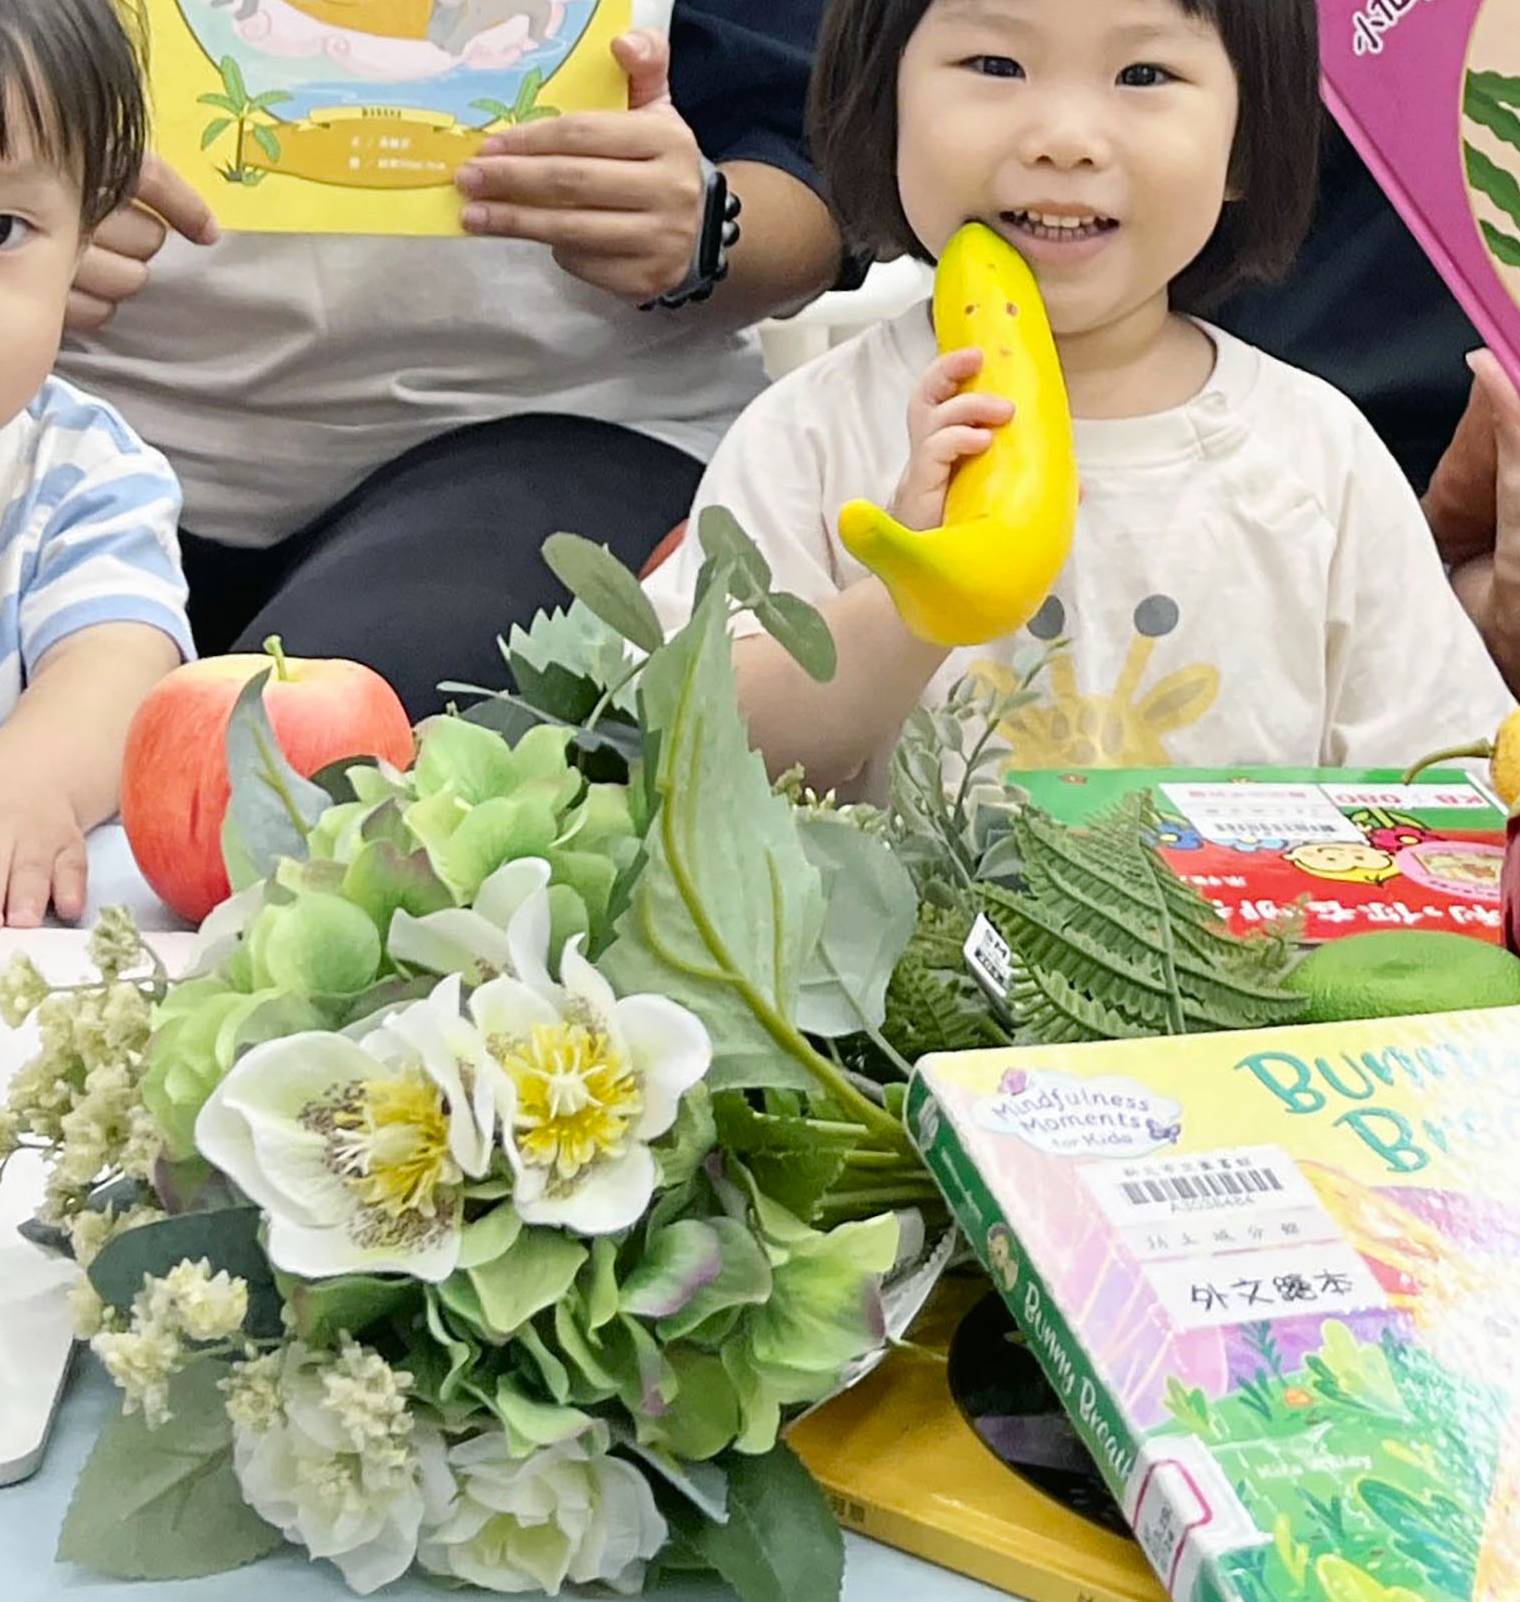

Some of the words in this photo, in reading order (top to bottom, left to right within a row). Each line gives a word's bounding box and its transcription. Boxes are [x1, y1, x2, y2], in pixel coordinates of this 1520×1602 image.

[992, 1085, 1150, 1120] Mindfulness
[1020, 1112, 1142, 1135] Moments
[1084, 1131, 1134, 1148] Kids
[1024, 1281, 1075, 1396] Bunny
